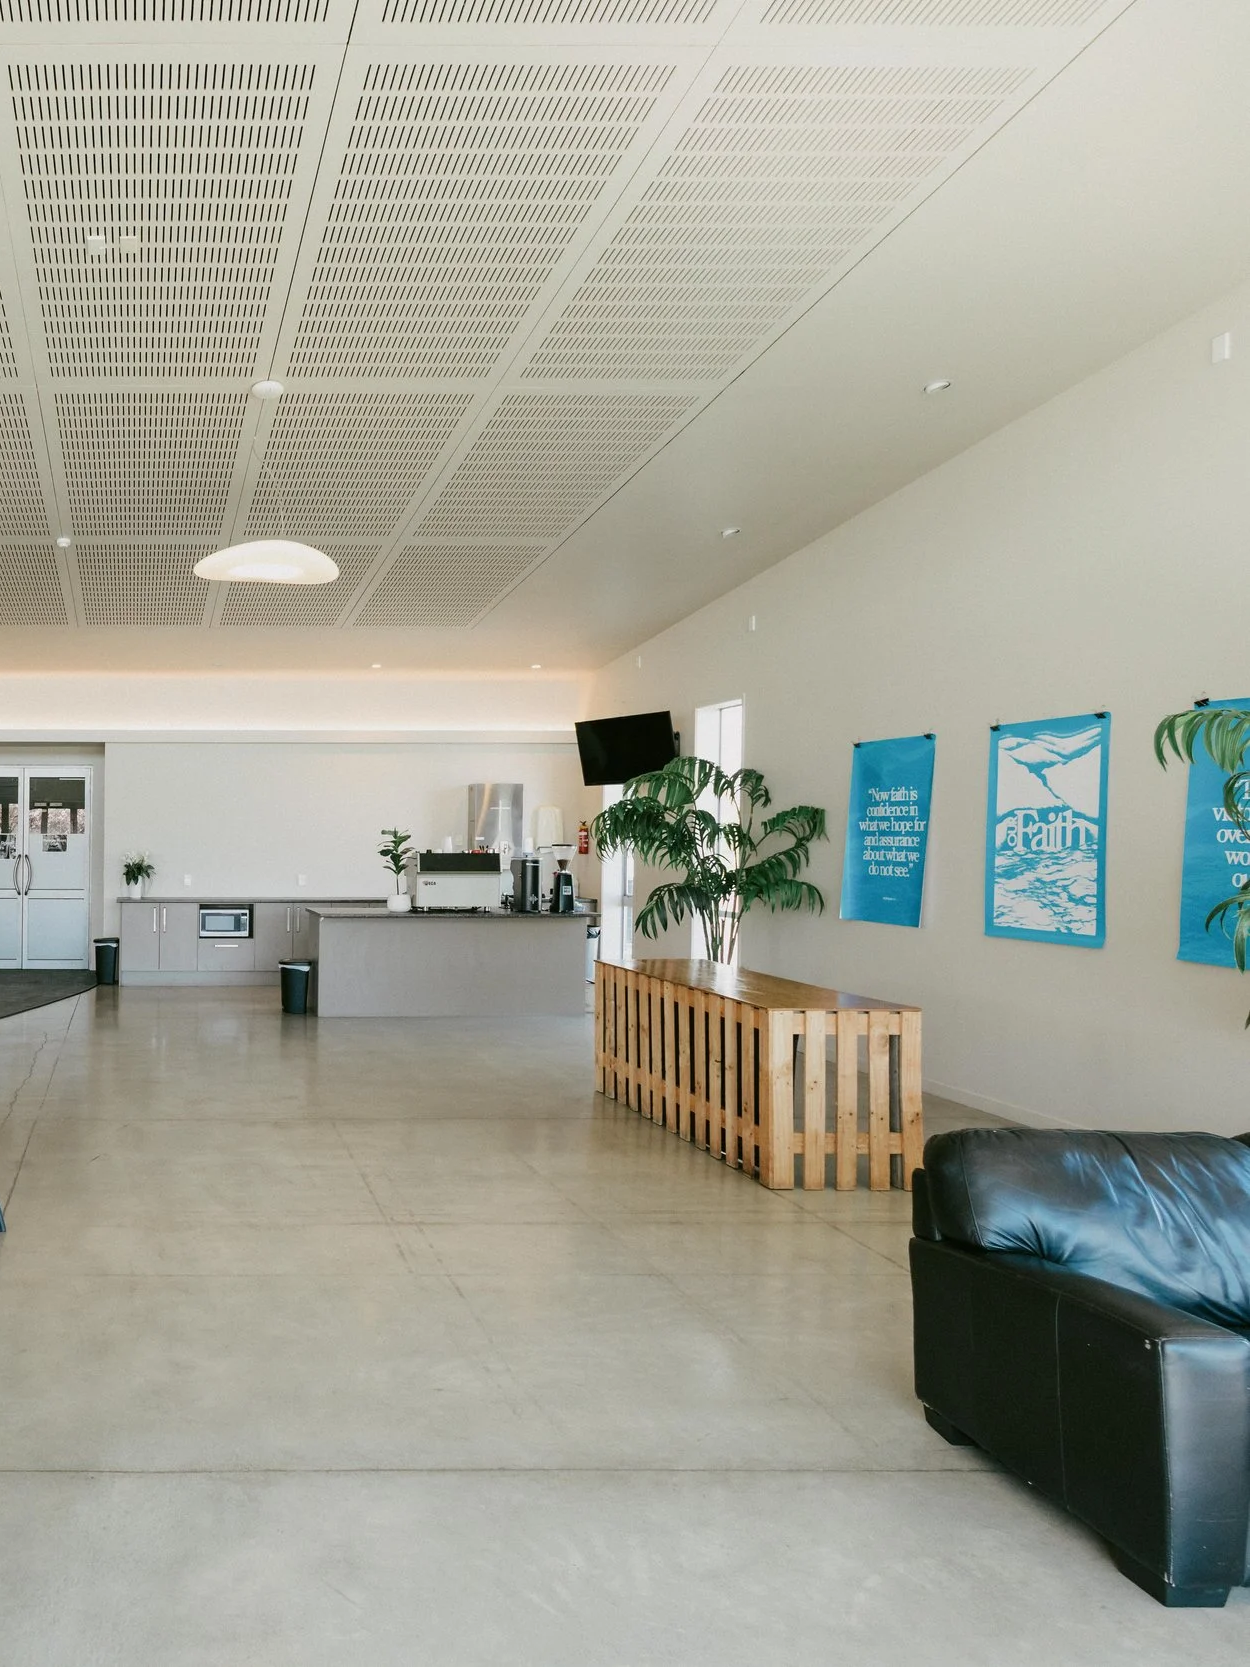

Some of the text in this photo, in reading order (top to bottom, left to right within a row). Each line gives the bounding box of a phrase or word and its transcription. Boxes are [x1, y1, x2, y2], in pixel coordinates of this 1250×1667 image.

[868, 786, 918, 802] "Now faith is
[866, 801, 919, 817] confidence in
[858, 817, 927, 834] what we hope for
[864, 832, 920, 847] and assurance
[862, 846, 920, 863] about what we
[868, 861, 914, 877] do not see."
